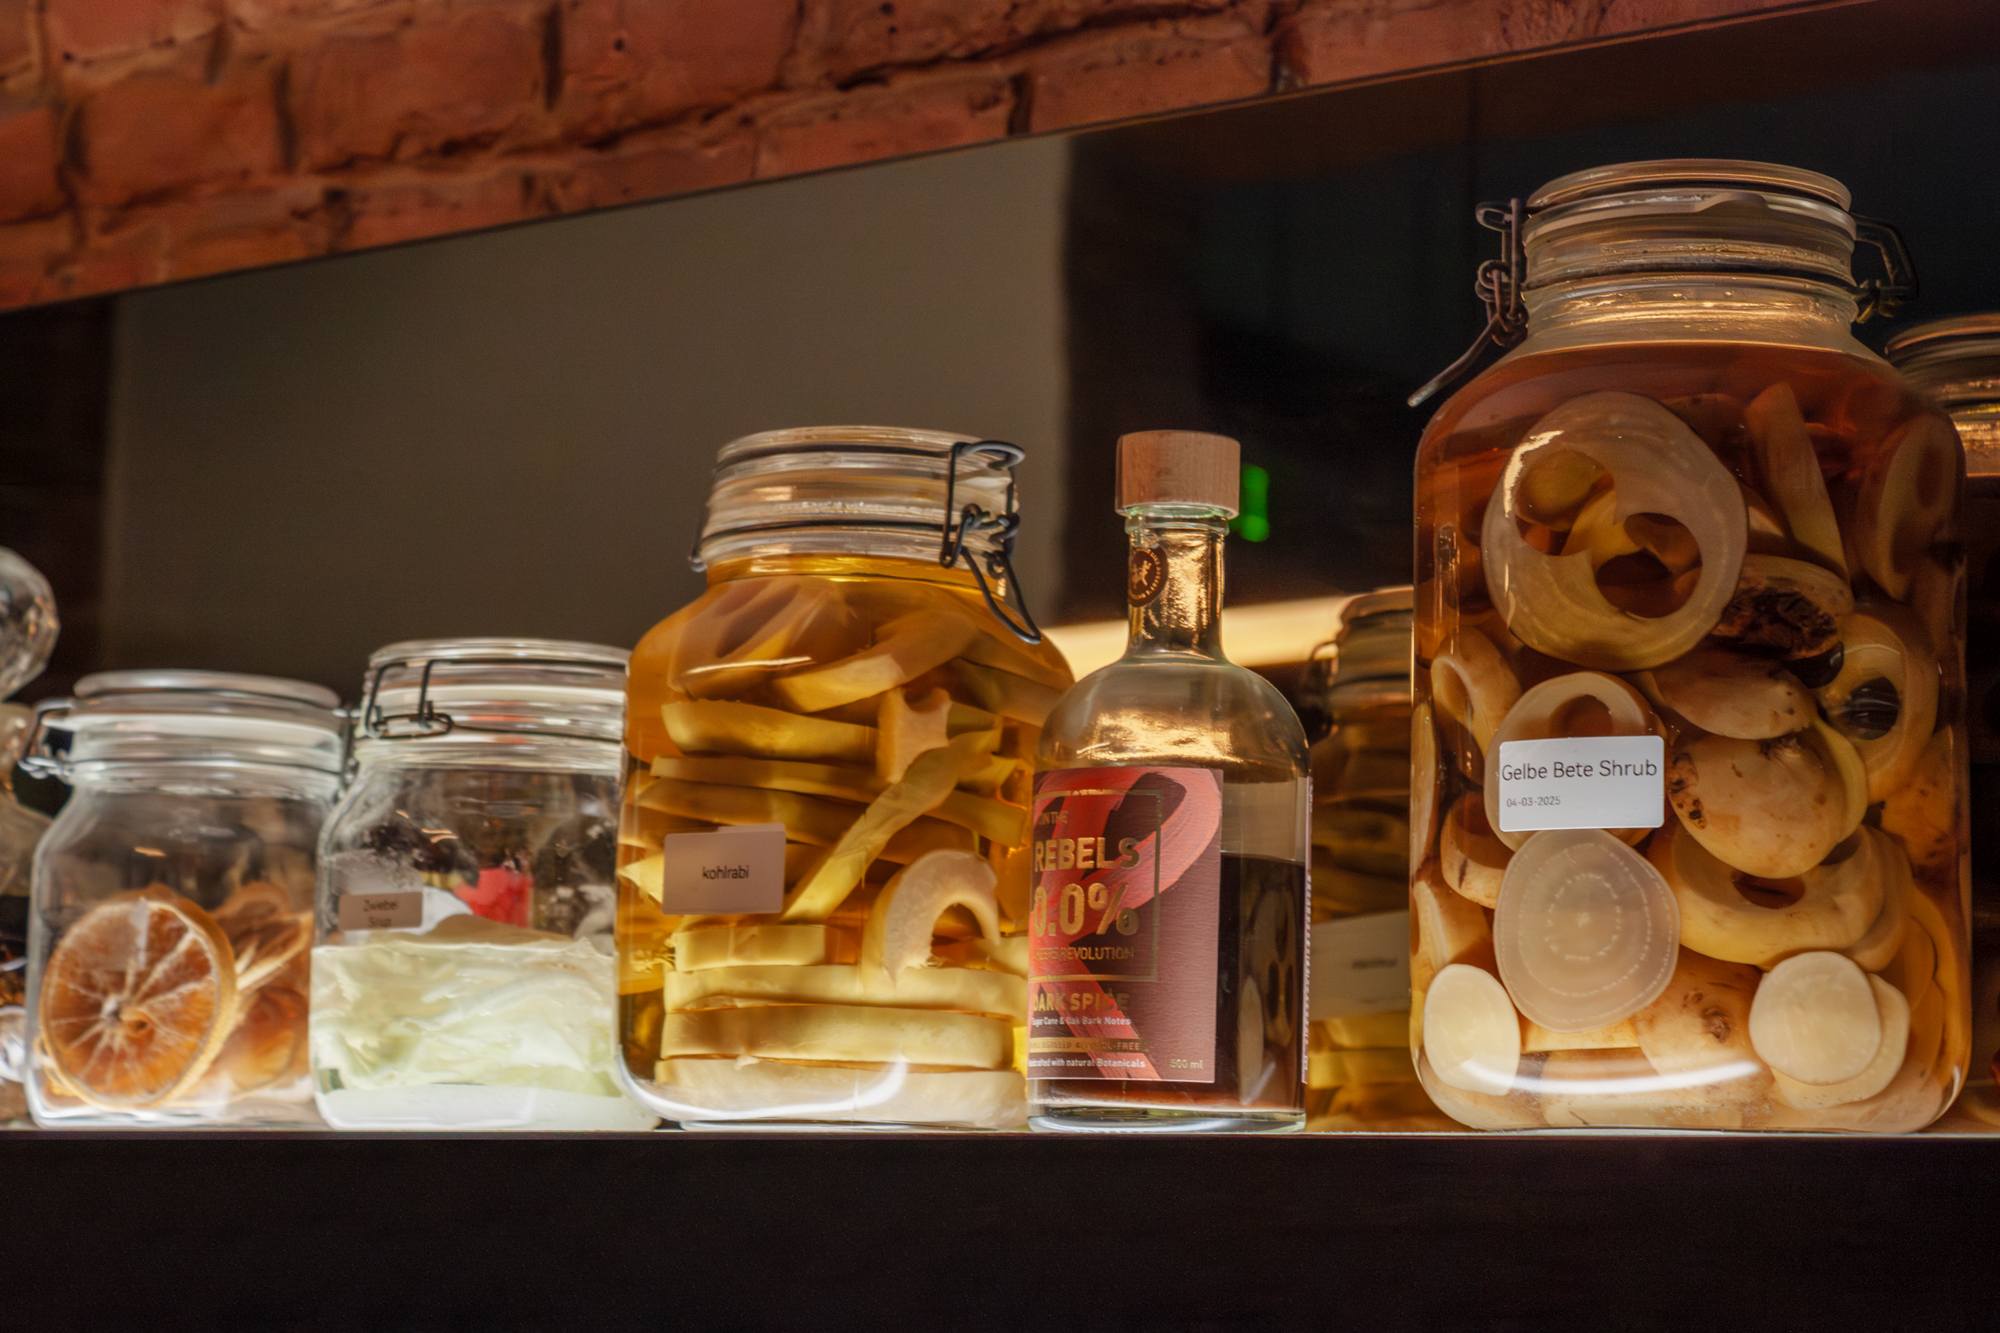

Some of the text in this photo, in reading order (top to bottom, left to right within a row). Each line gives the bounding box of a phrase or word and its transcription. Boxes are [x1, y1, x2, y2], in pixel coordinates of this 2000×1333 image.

[1502, 759, 1658, 781] Gelbe Bete Shrub
[1506, 796, 1561, 807] 04-03-2025
[1034, 837, 1140, 872] REBELS
[702, 865, 750, 880] kohlrabi
[1034, 882, 1139, 937] 0.0%
[1060, 947, 1134, 960] REVOLUTION
[1032, 992, 1068, 1012] DARK
[1104, 1016, 1132, 1026] Notes
[1051, 1057, 1065, 1067] with
[1066, 1058, 1095, 1067] natural
[1097, 1057, 1146, 1068] Botanicals
[1170, 1059, 1188, 1069] 500
